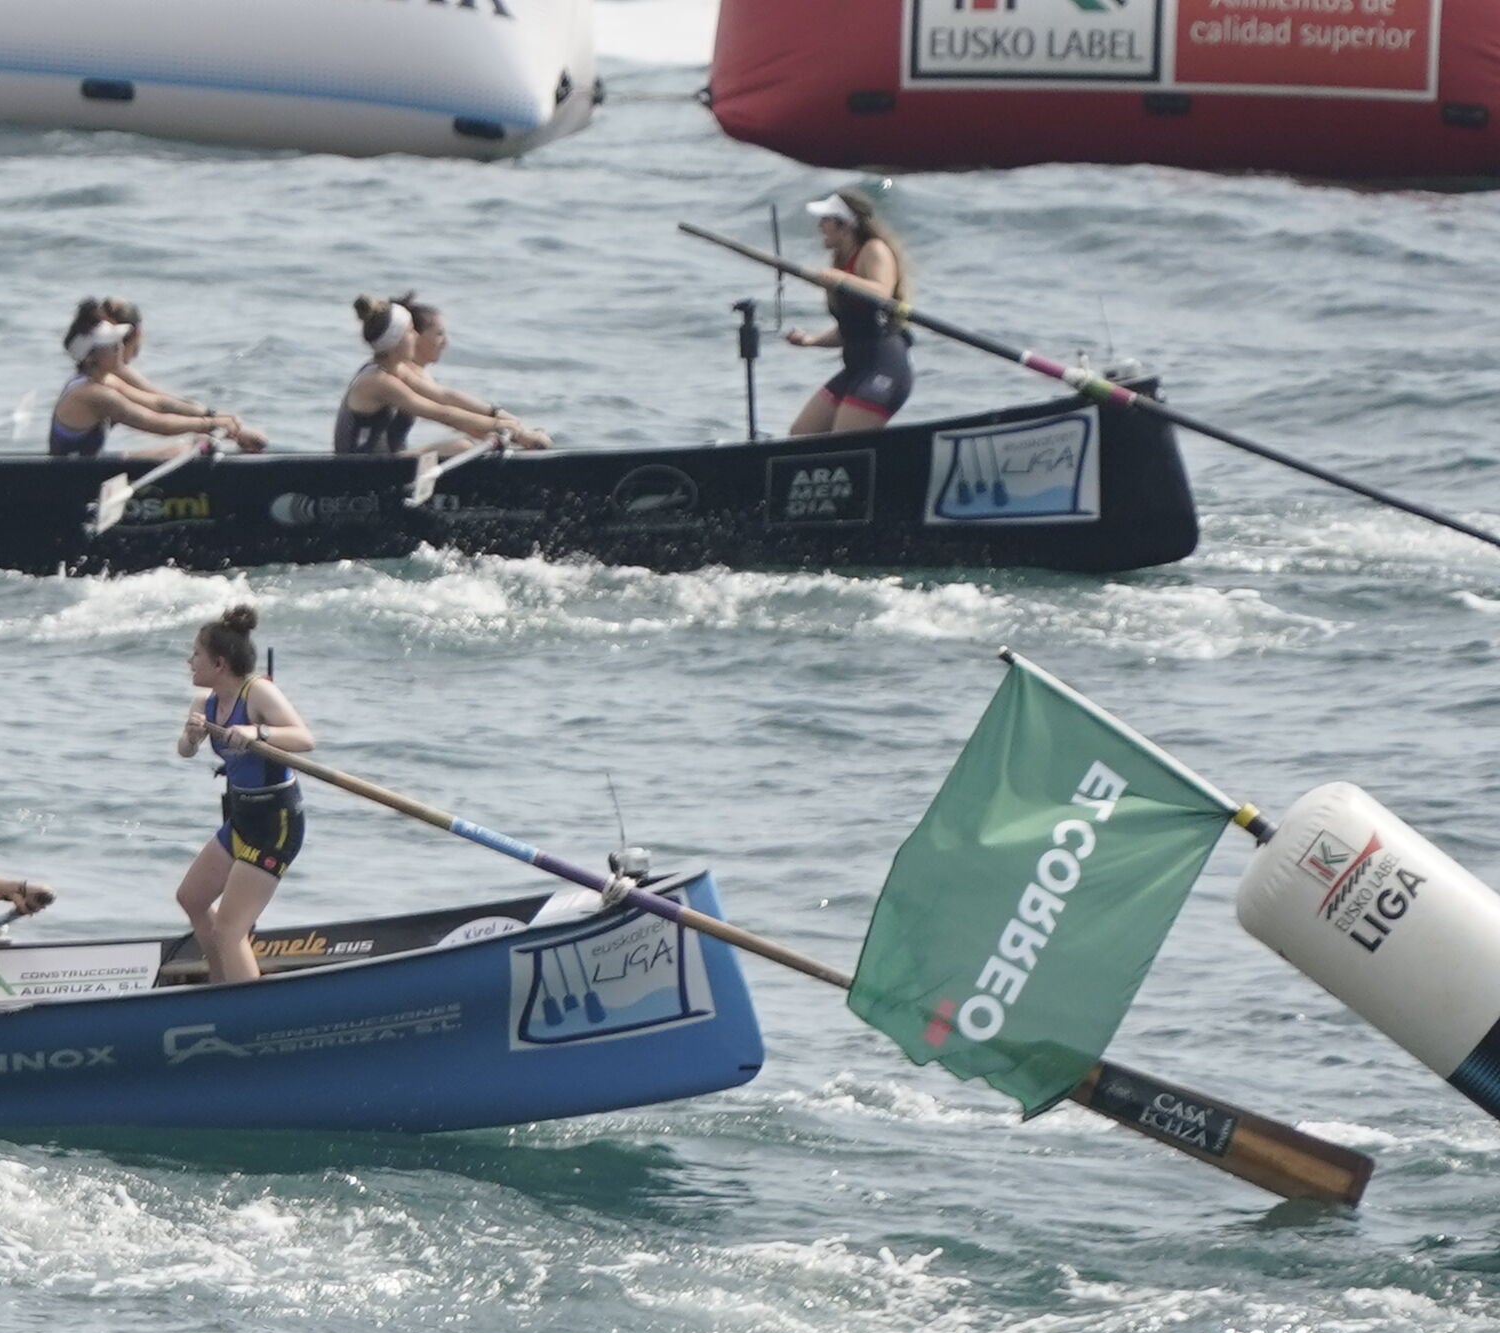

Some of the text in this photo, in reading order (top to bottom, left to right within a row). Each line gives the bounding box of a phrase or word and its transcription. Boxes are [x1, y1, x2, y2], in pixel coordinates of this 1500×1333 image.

[929, 27, 1144, 62] EUSKO LABEL
[1190, 17, 1416, 53] calidad superior
[1349, 867, 1428, 953] LIGA
[20, 966, 149, 981] CONSTRUCCIONES
[591, 937, 675, 985] LIGA
